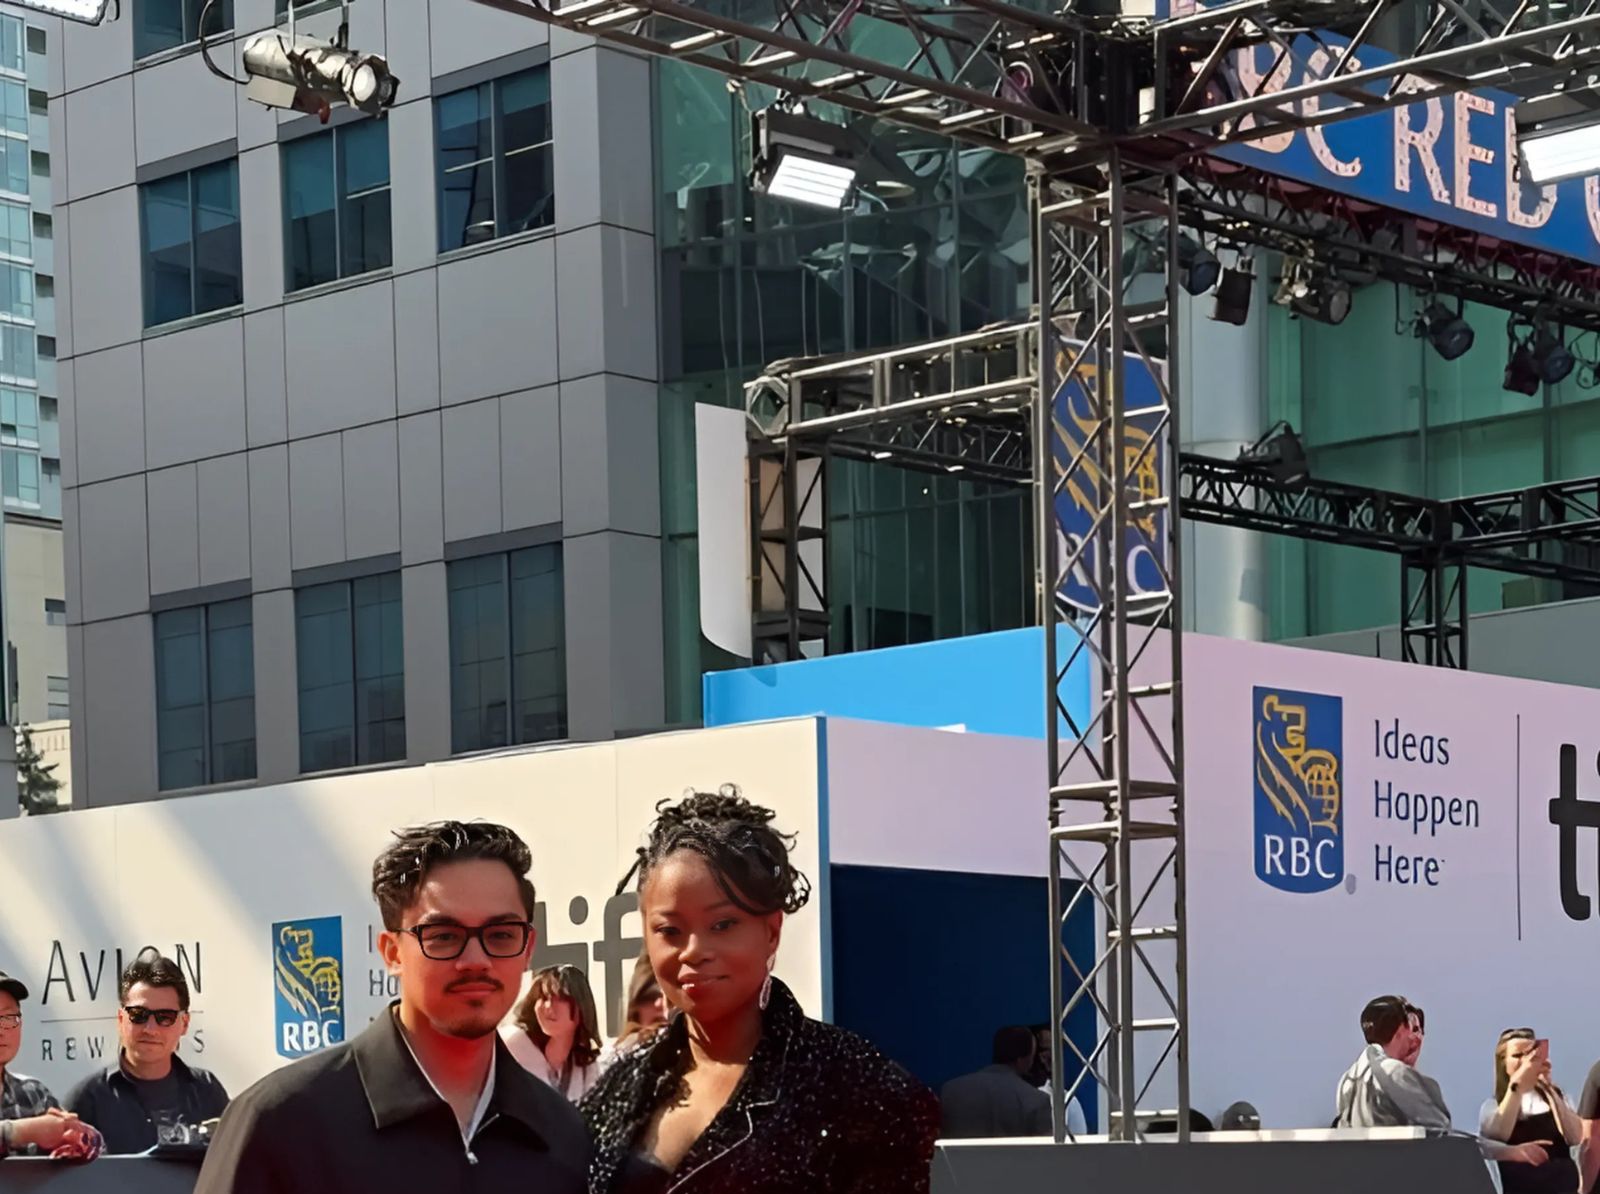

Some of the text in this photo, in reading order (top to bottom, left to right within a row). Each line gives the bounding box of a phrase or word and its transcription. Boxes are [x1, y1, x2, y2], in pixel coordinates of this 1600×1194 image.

[1055, 530, 1168, 598] RC
[1375, 718, 1449, 765] Ideas
[1375, 780, 1479, 837] Happen
[1264, 834, 1336, 879] RBC
[1375, 844, 1439, 886] Here
[42, 1029, 204, 1060] REWS
[283, 1020, 339, 1051] RBC
